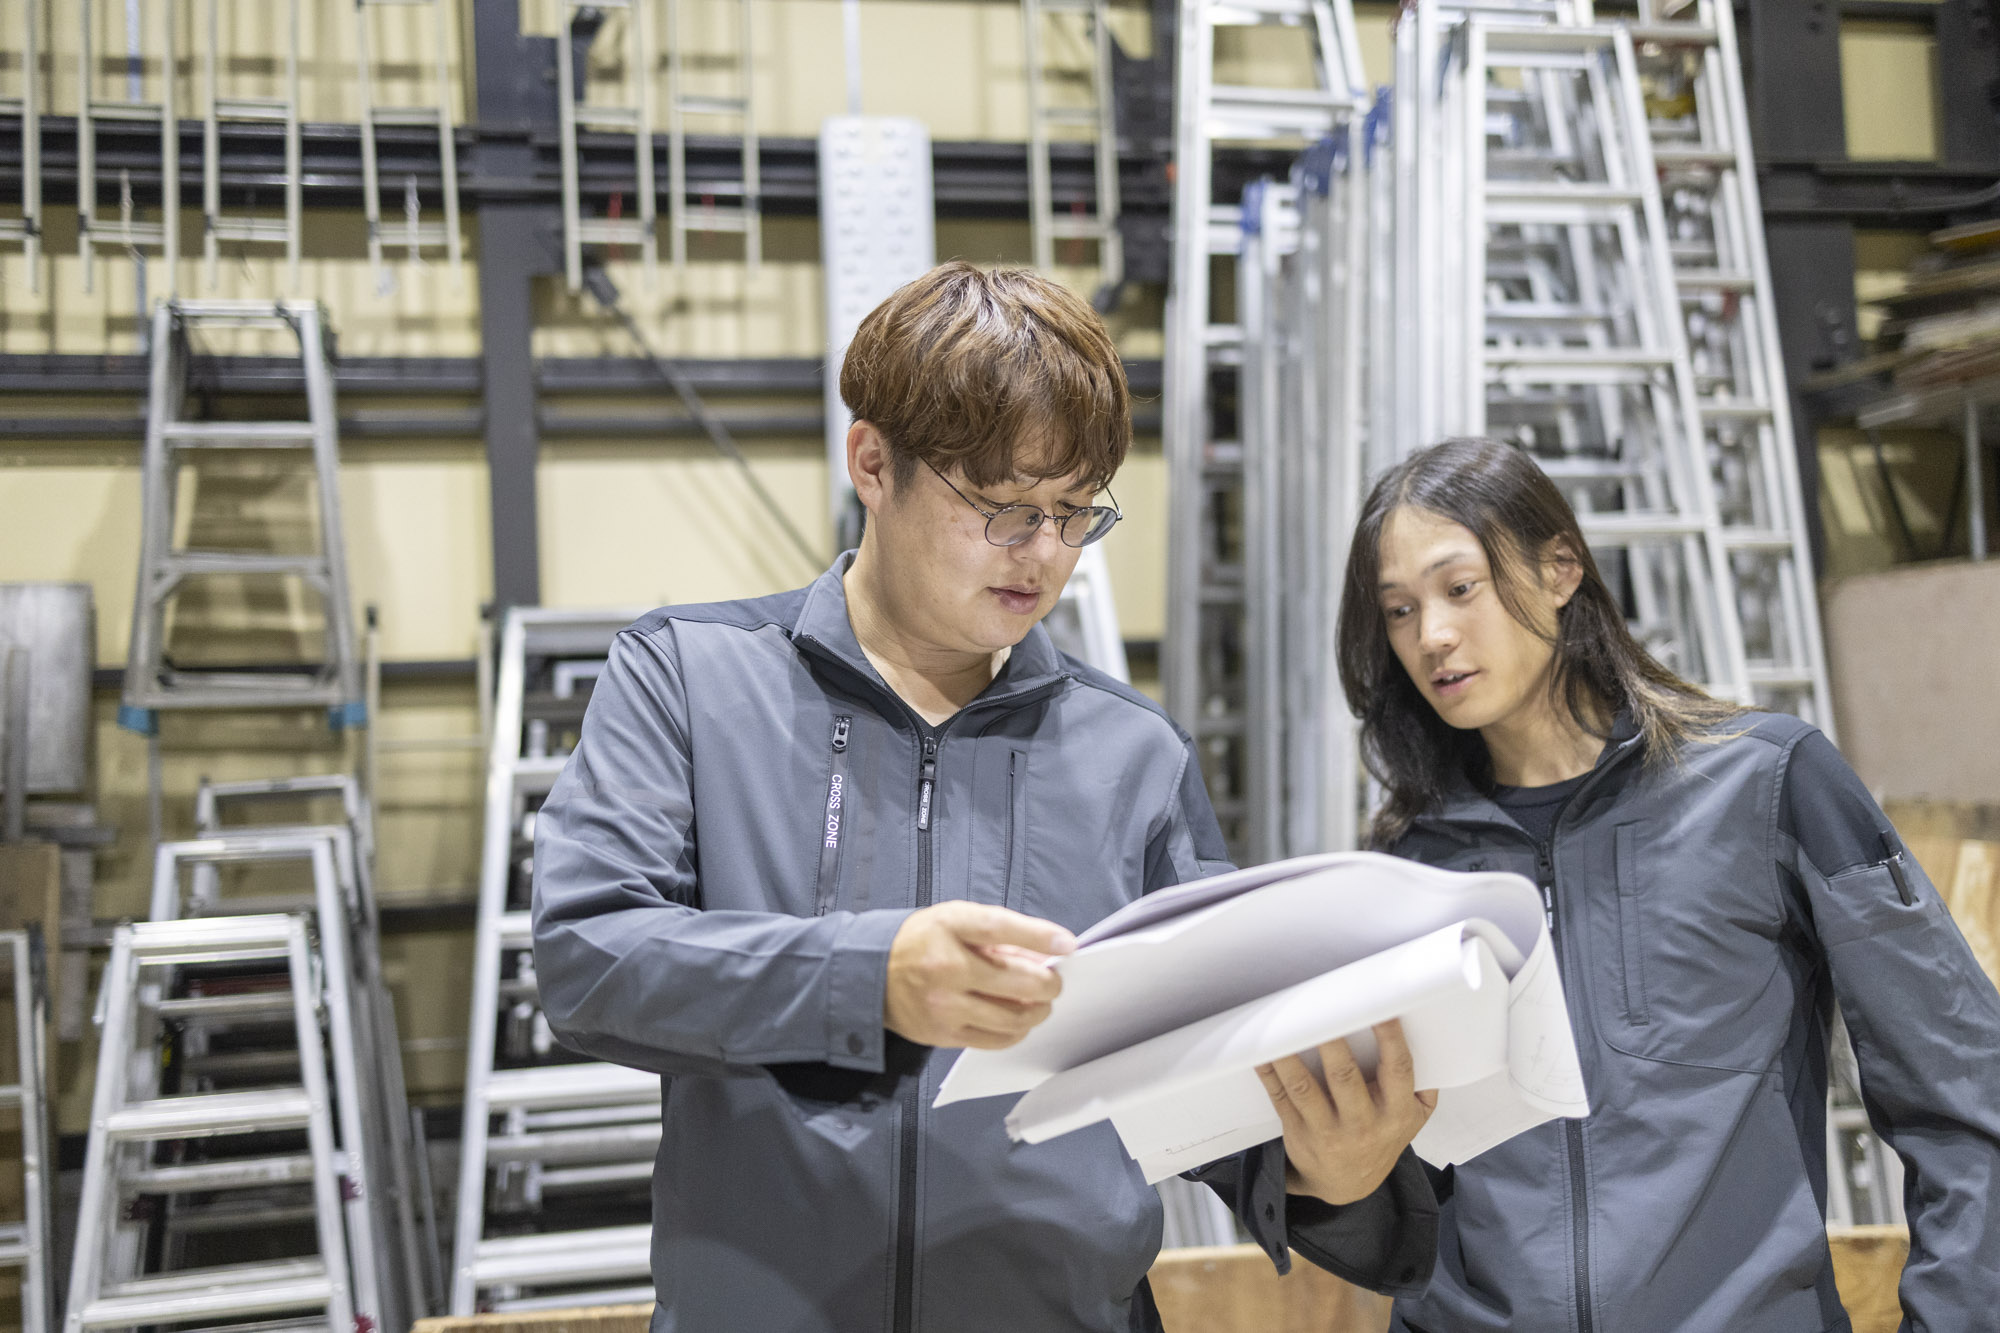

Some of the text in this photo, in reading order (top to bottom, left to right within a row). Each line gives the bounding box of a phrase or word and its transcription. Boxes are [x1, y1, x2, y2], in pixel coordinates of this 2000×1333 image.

[825, 774, 842, 848] CROSS ZONE
[922, 781, 930, 803] CROSS
